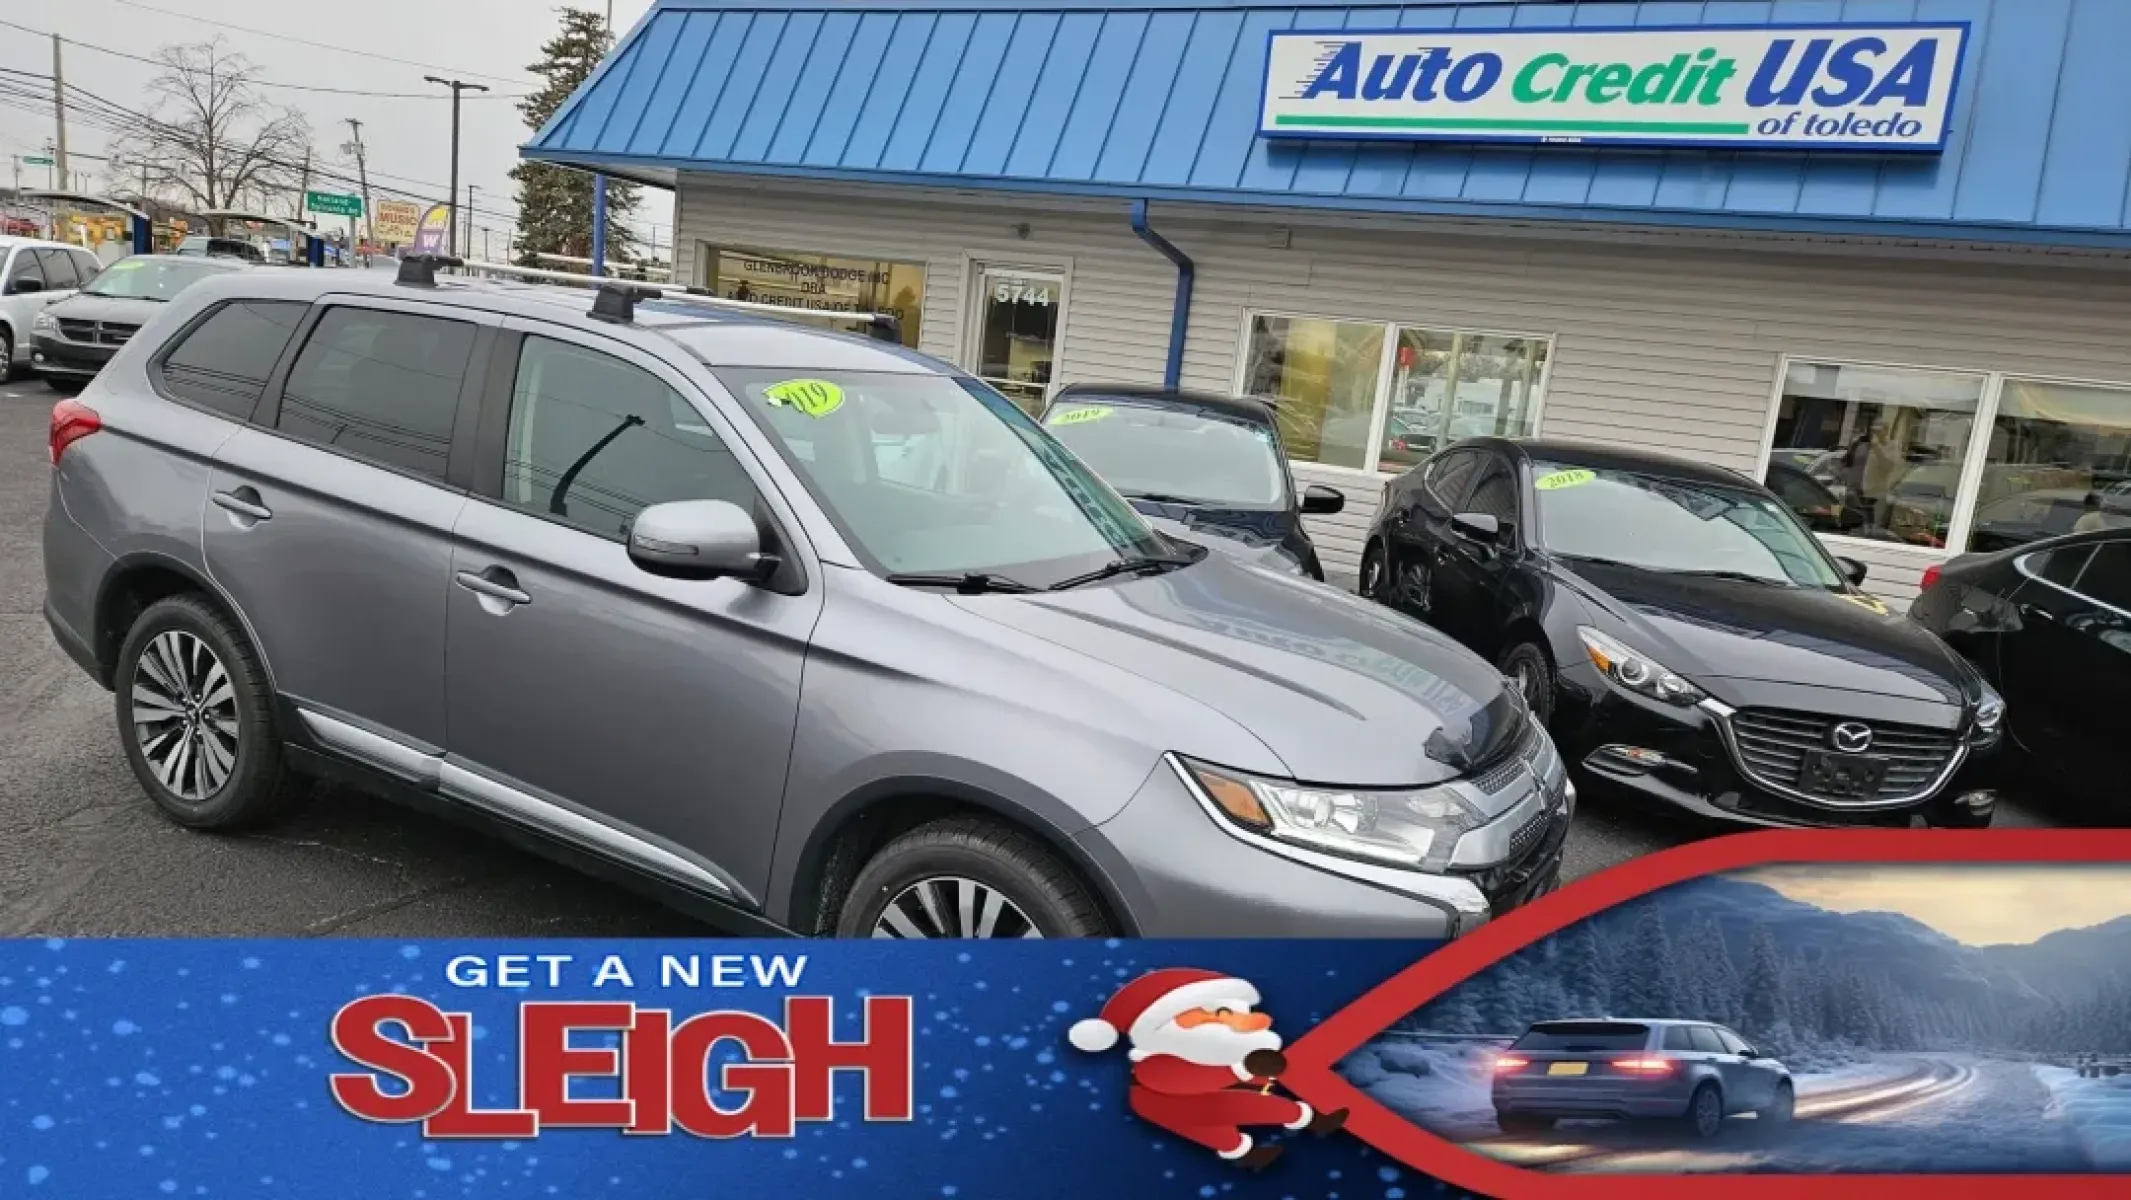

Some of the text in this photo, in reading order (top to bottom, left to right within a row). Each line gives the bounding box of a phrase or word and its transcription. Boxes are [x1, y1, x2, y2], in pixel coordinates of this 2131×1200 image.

[1290, 36, 1939, 108] Auto Credit USA
[1757, 110, 1923, 137] of toledo
[379, 212, 417, 226] MUSIC
[822, 265, 865, 283] DODGE
[996, 283, 1049, 307] 5744
